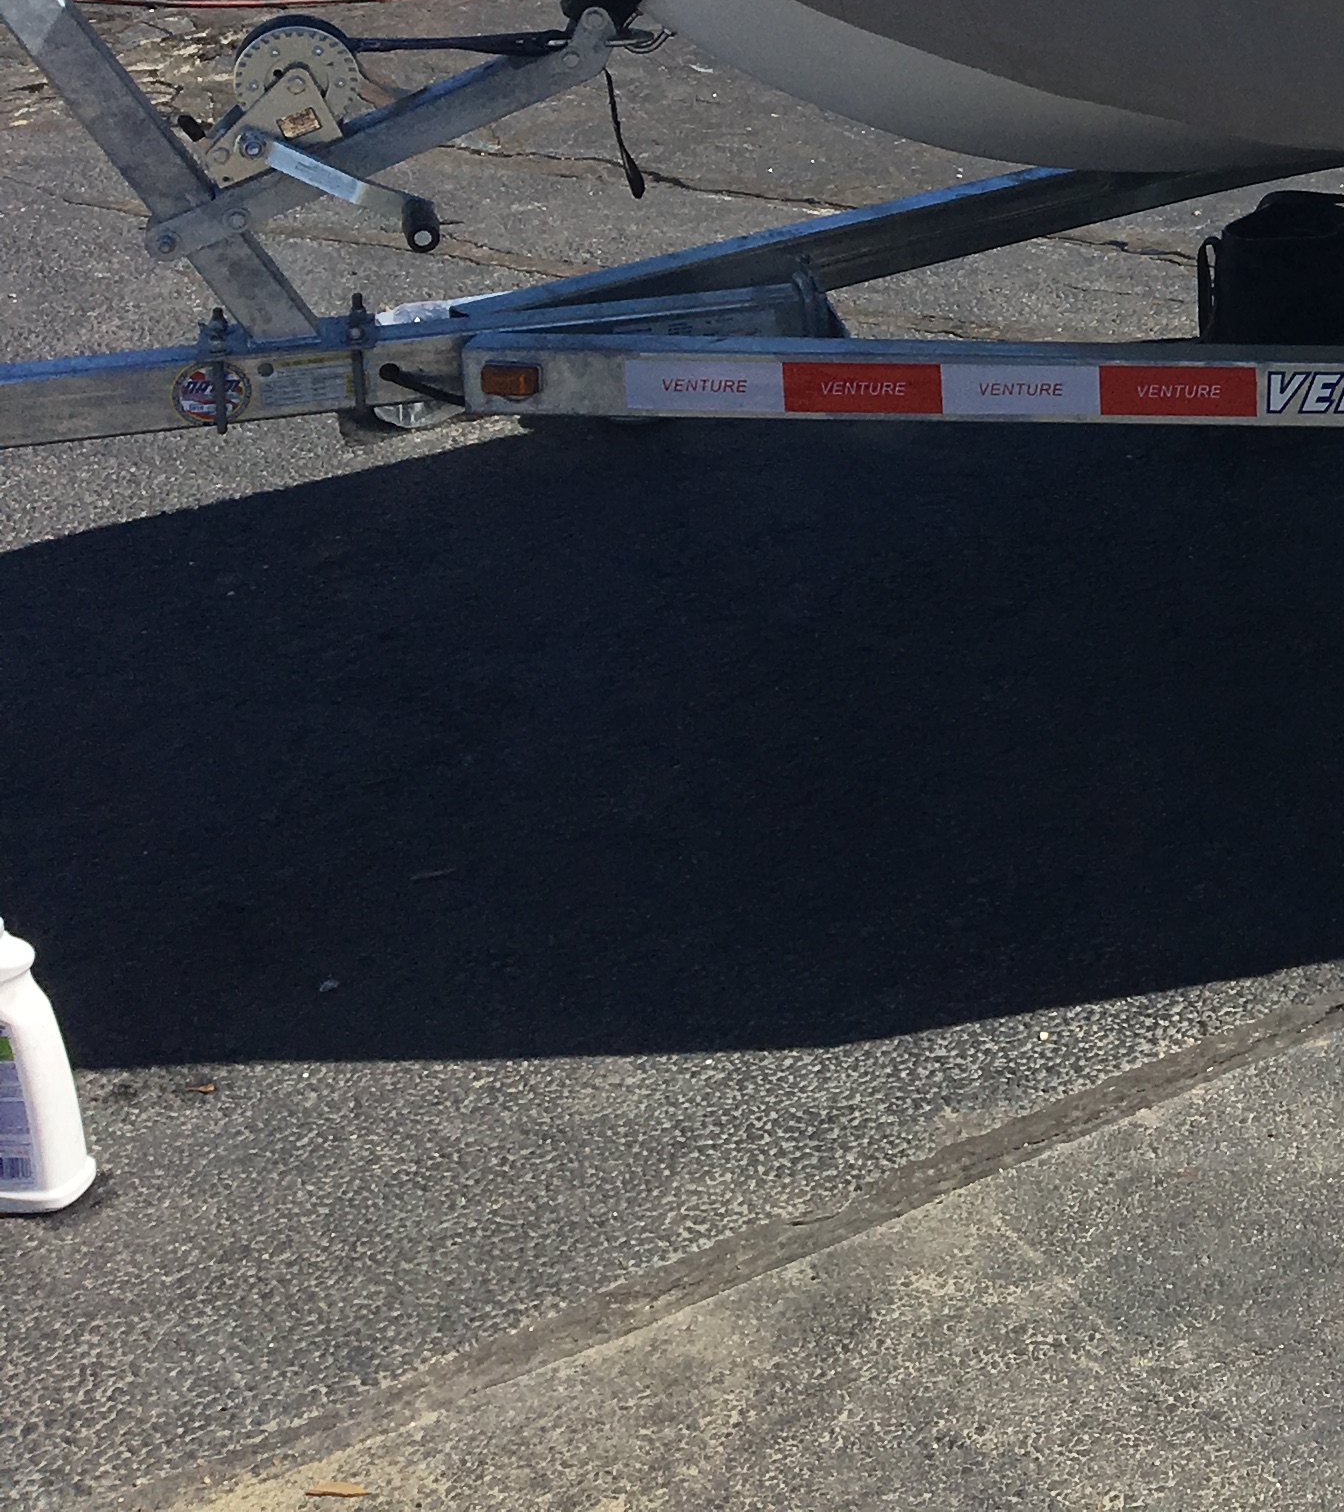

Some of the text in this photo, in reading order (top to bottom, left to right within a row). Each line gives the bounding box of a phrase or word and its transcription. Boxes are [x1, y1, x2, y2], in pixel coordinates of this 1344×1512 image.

[661, 378, 748, 394] VENTURE
[820, 381, 907, 396] VENTURE
[979, 382, 1064, 397] VENTURE
[1136, 384, 1222, 399] VENTURE
